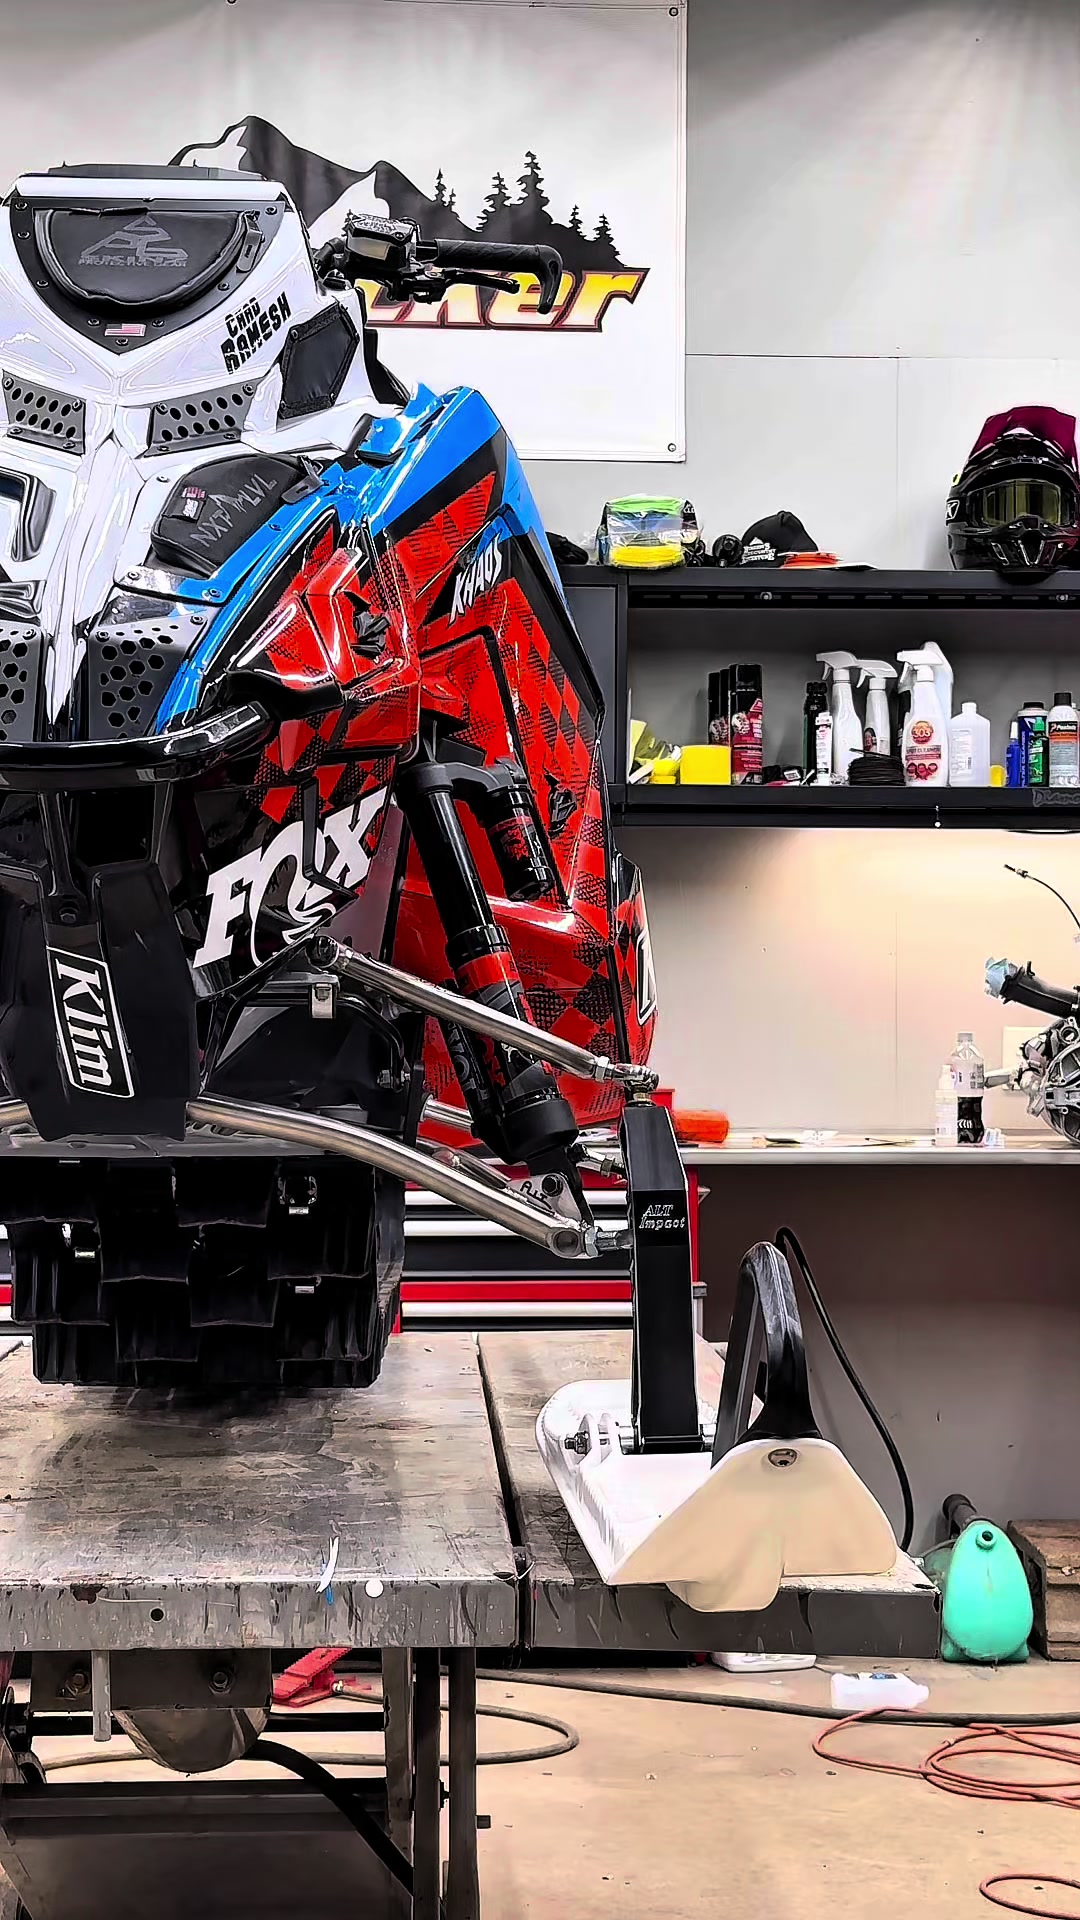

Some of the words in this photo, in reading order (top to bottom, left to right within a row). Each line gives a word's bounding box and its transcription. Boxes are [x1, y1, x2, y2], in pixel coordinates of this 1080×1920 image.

[221, 291, 291, 375] RAMESH
[449, 533, 503, 625] KHAOS
[192, 786, 388, 968] FOX
